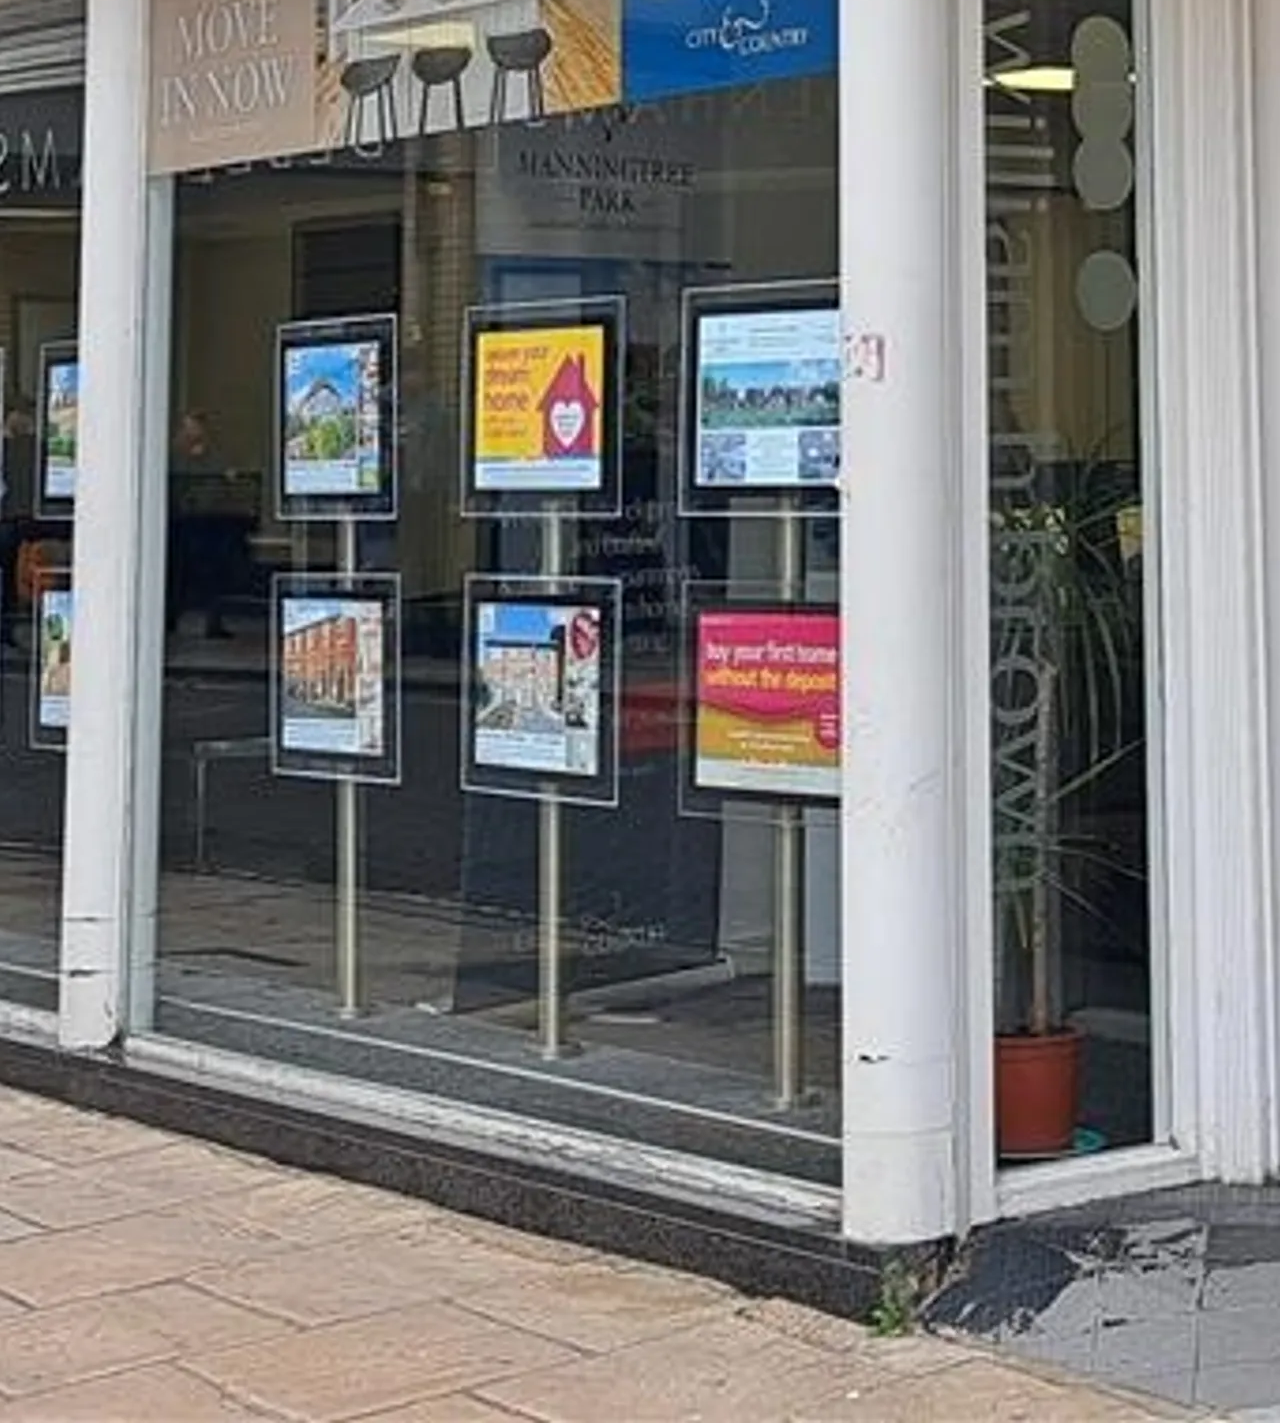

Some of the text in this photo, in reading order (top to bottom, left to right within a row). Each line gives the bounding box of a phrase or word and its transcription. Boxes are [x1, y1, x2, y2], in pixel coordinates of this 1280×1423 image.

[161, 55, 294, 126] IN NOW
[519, 151, 697, 187] MANNINGTREE
[579, 186, 638, 215] PARK
